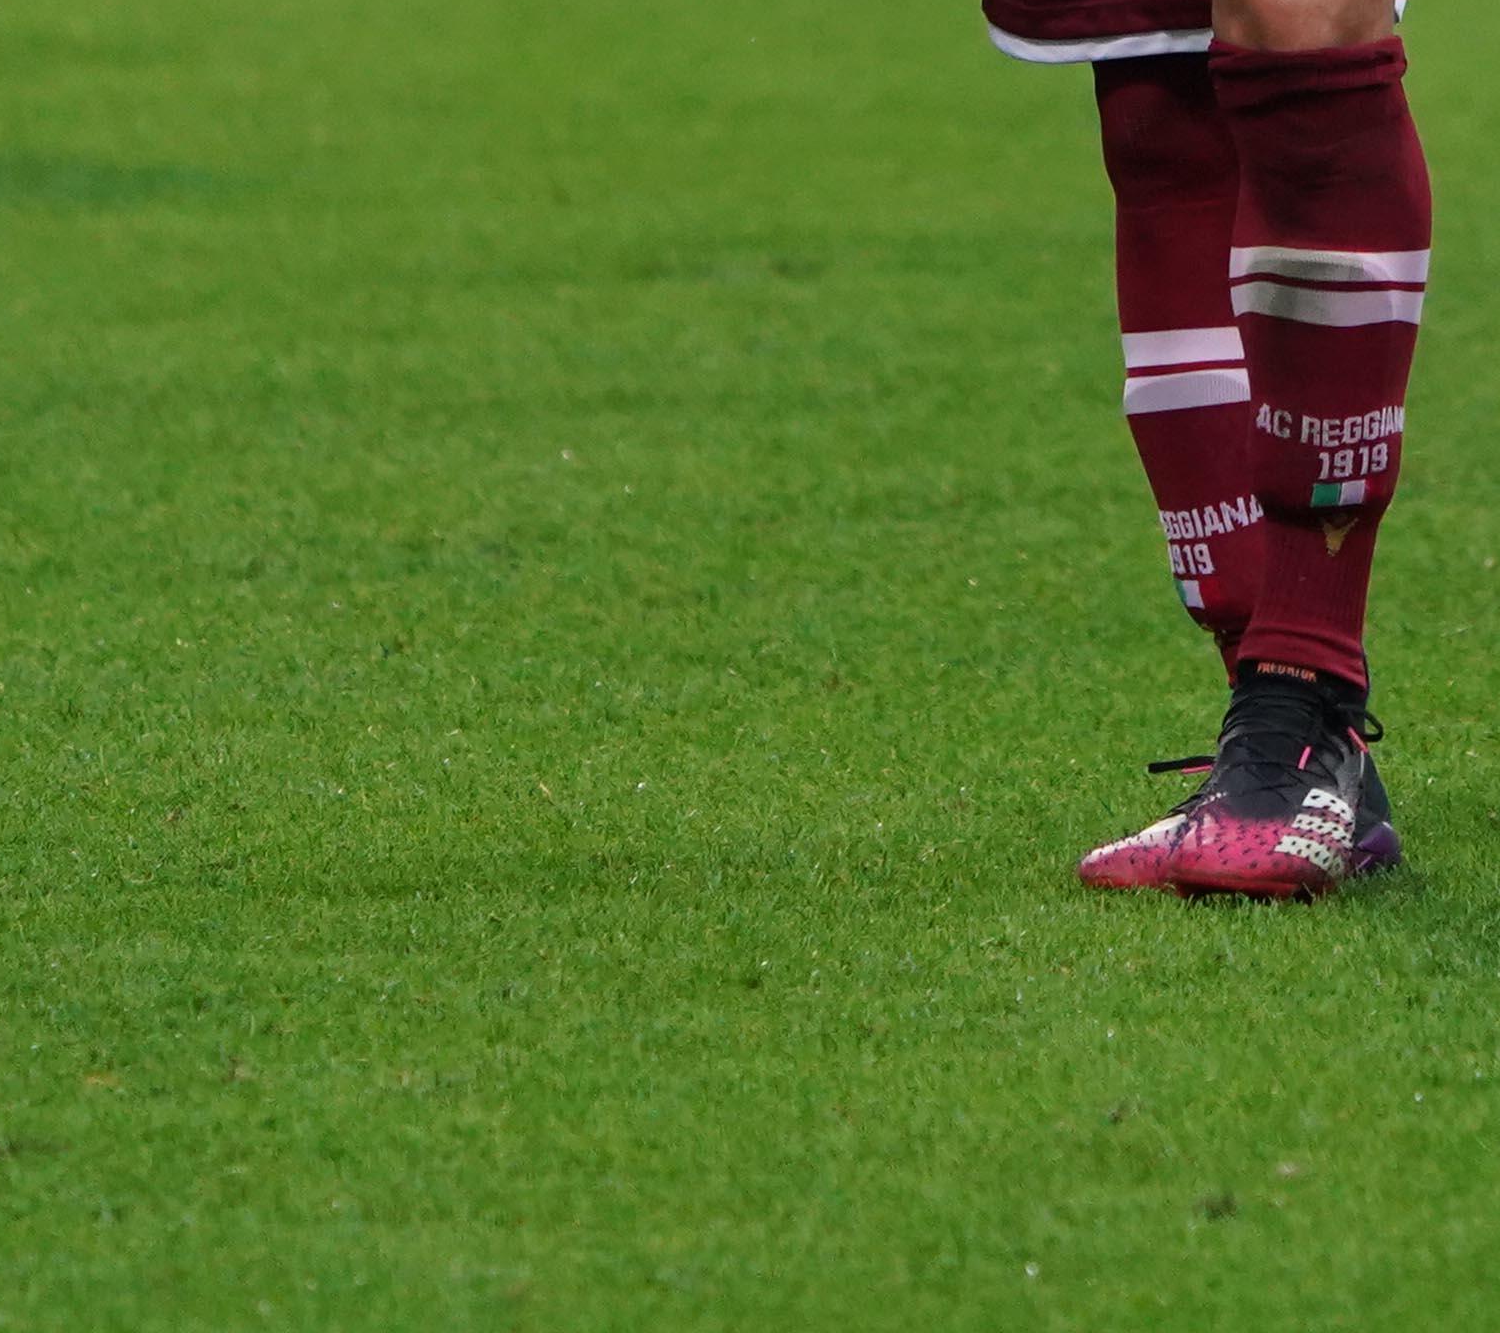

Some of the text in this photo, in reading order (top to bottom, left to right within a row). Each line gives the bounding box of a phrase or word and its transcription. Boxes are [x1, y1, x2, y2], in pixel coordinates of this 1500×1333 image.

[1256, 403, 1406, 448] AC REGGIAN
[1318, 442, 1389, 480] 1919
